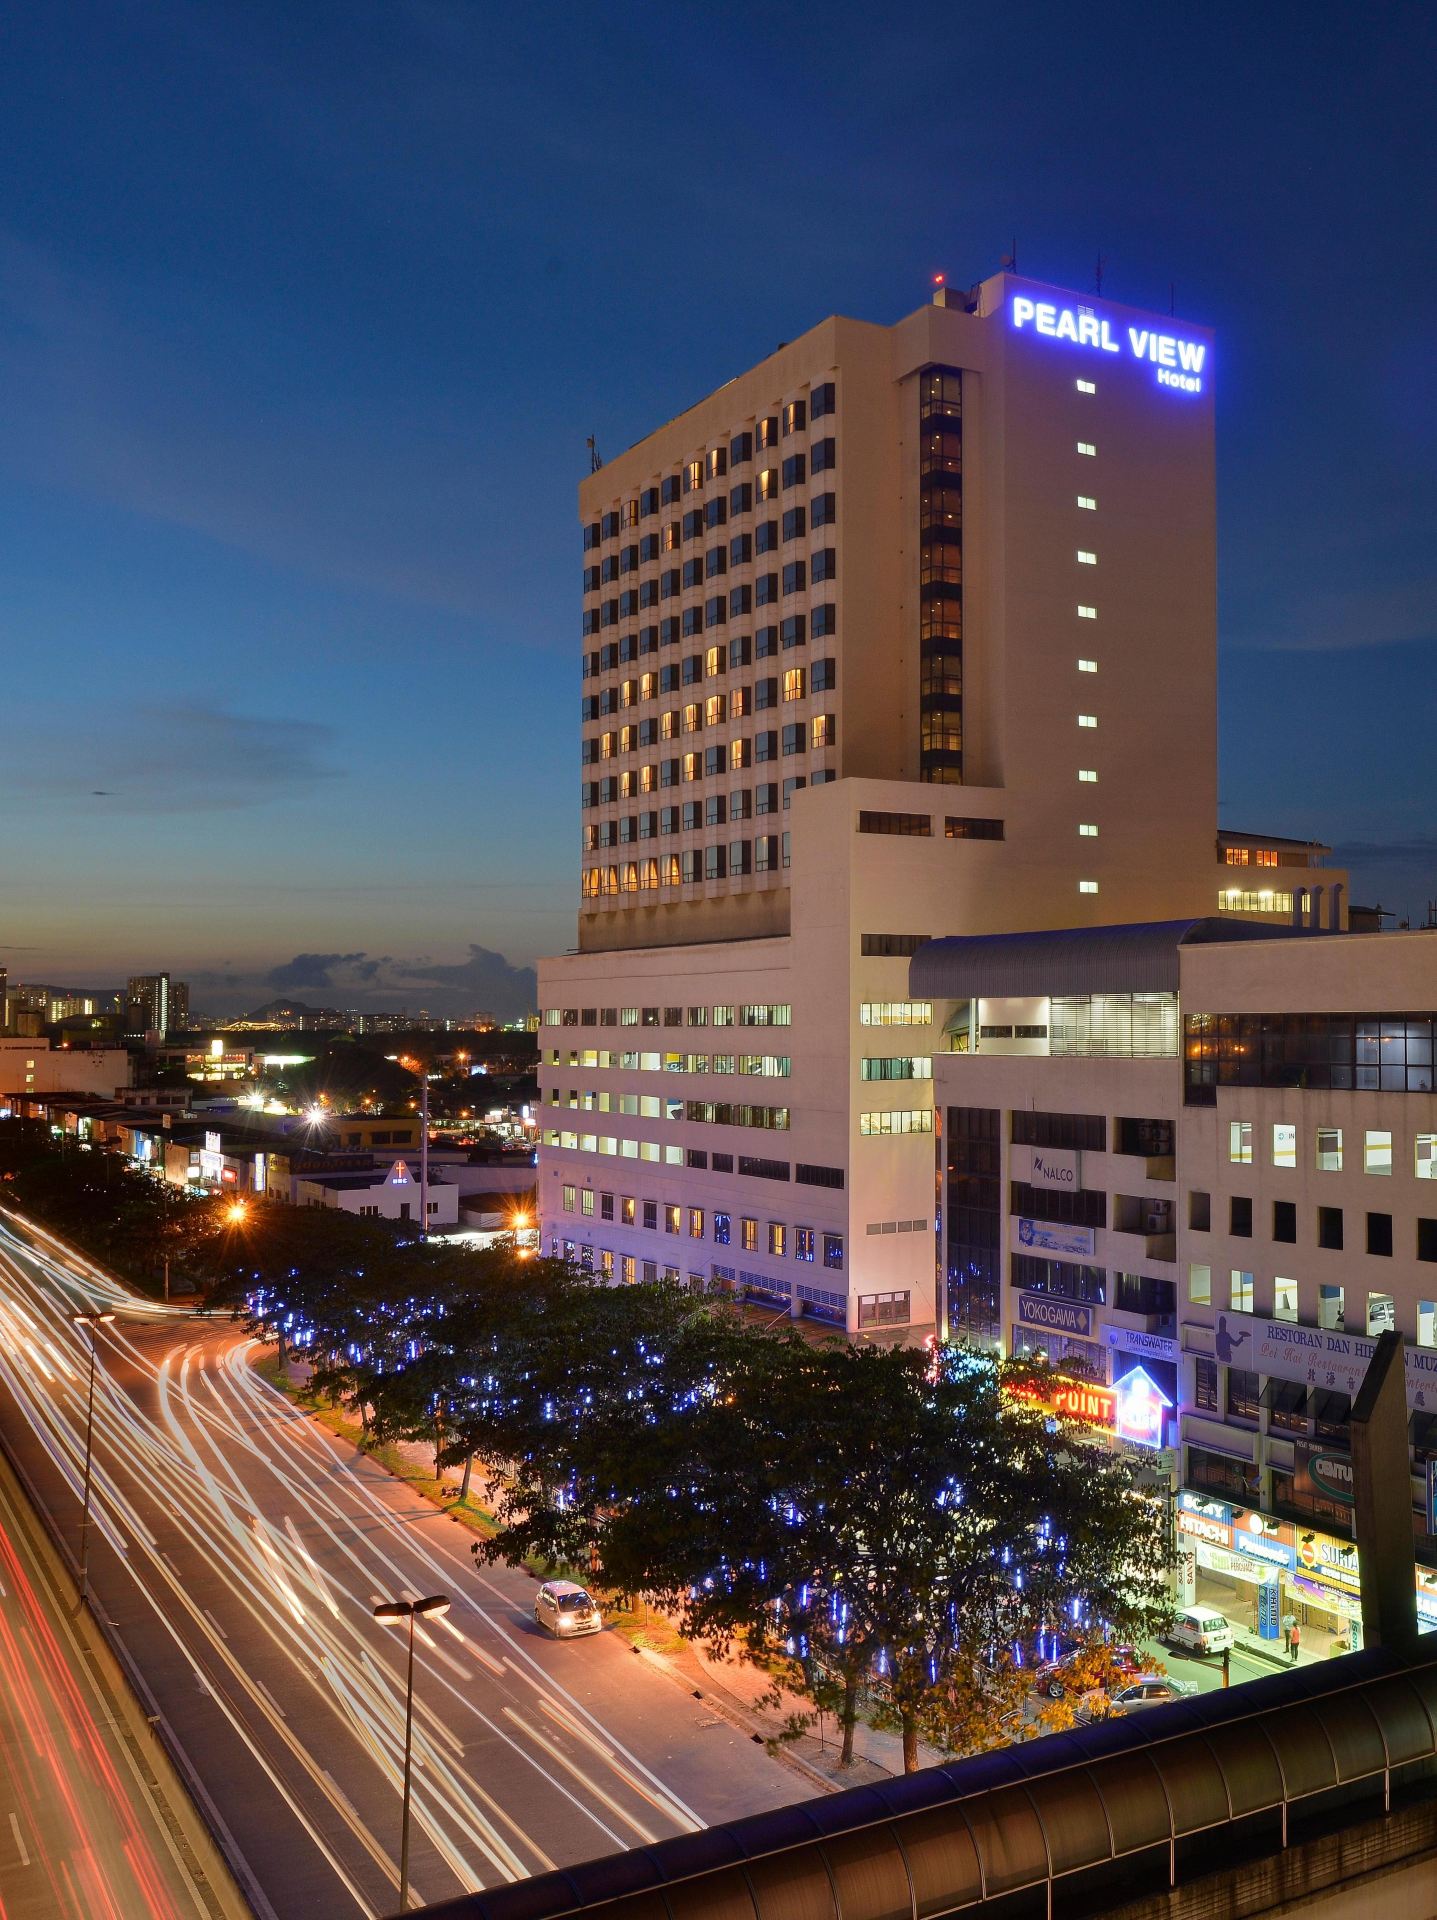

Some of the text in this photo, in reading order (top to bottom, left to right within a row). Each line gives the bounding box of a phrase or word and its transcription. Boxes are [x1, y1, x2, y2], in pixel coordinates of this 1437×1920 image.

[1013, 297, 1206, 373] PEARL VIEW
[1157, 368, 1201, 393] Hotel
[1043, 1166, 1074, 1182] NALCO
[1021, 1300, 1077, 1329] YOKOGAWA
[1125, 1331, 1173, 1353] TRANSWATER
[1267, 1325, 1323, 1349] RESTORAN
[1327, 1336, 1350, 1355] DAN
[1056, 1390, 1112, 1418] POINT
[1315, 1459, 1354, 1482] CENTU
[1180, 1514, 1229, 1545] HITACHI
[1186, 1551, 1194, 1585] SANYO
